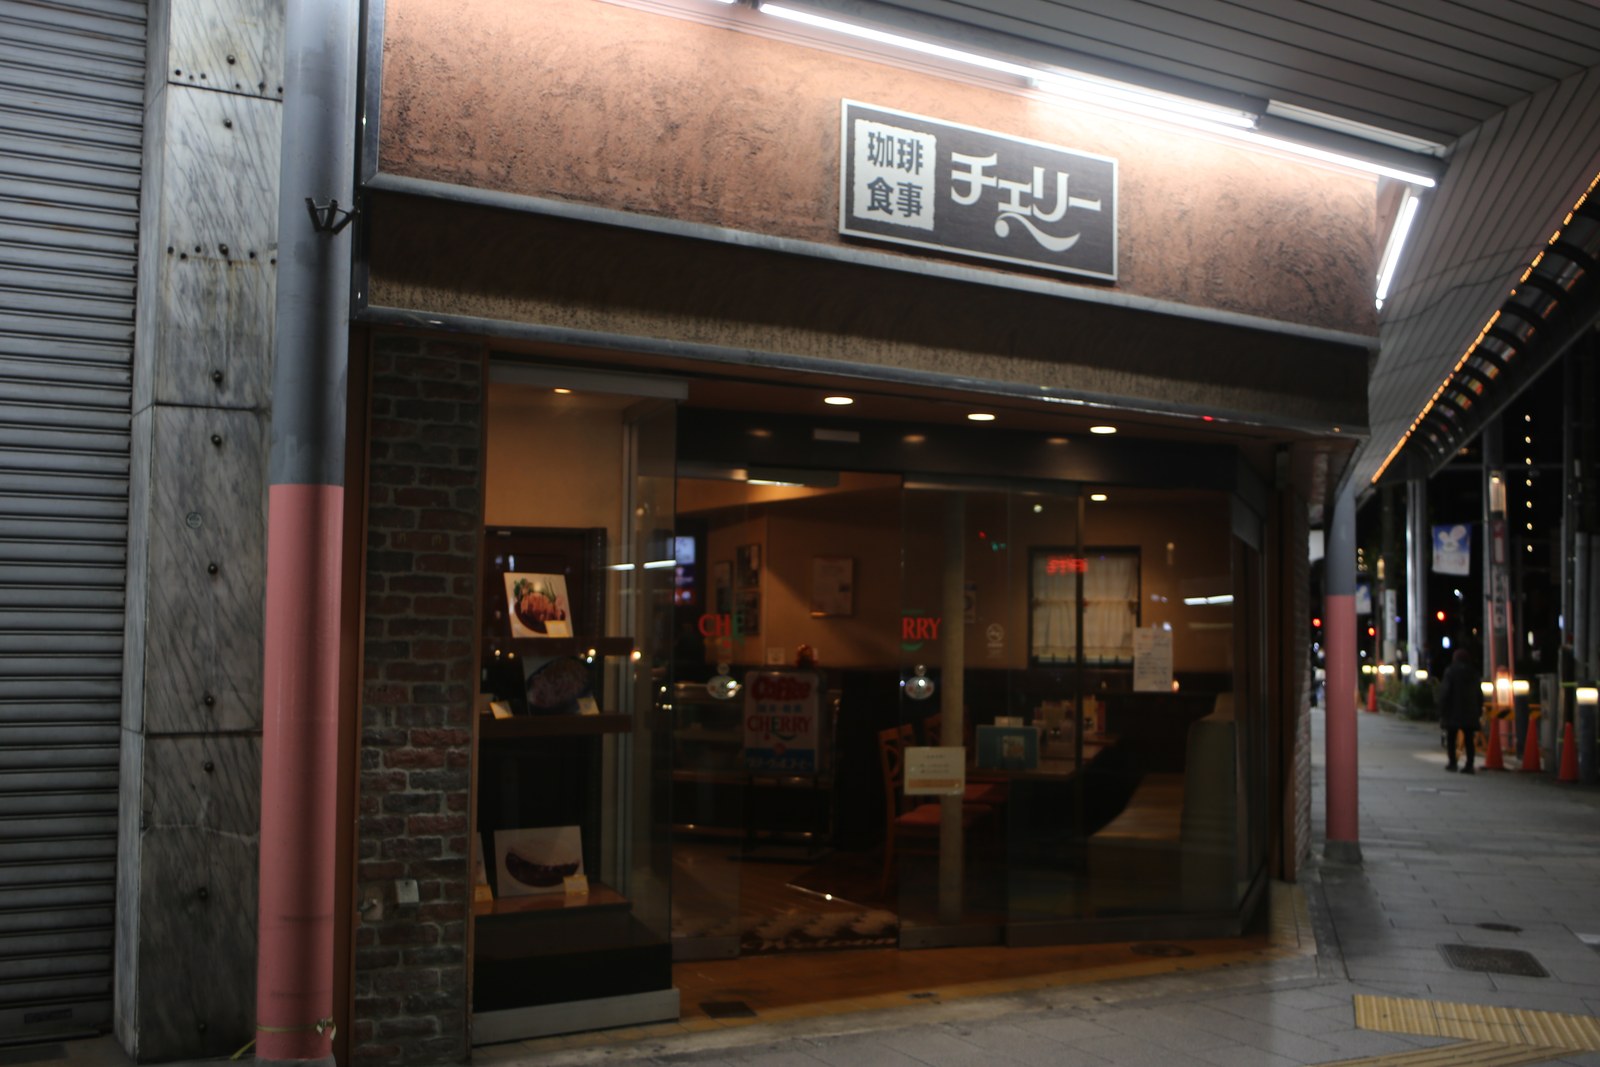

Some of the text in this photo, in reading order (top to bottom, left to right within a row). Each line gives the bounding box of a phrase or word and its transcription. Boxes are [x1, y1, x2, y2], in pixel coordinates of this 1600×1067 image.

[867, 131, 924, 175] 珈琲
[867, 177, 924, 218] 食事
[951, 152, 1101, 249] チェリー
[902, 617, 942, 640] RRY
[747, 715, 813, 734] CHERRY
